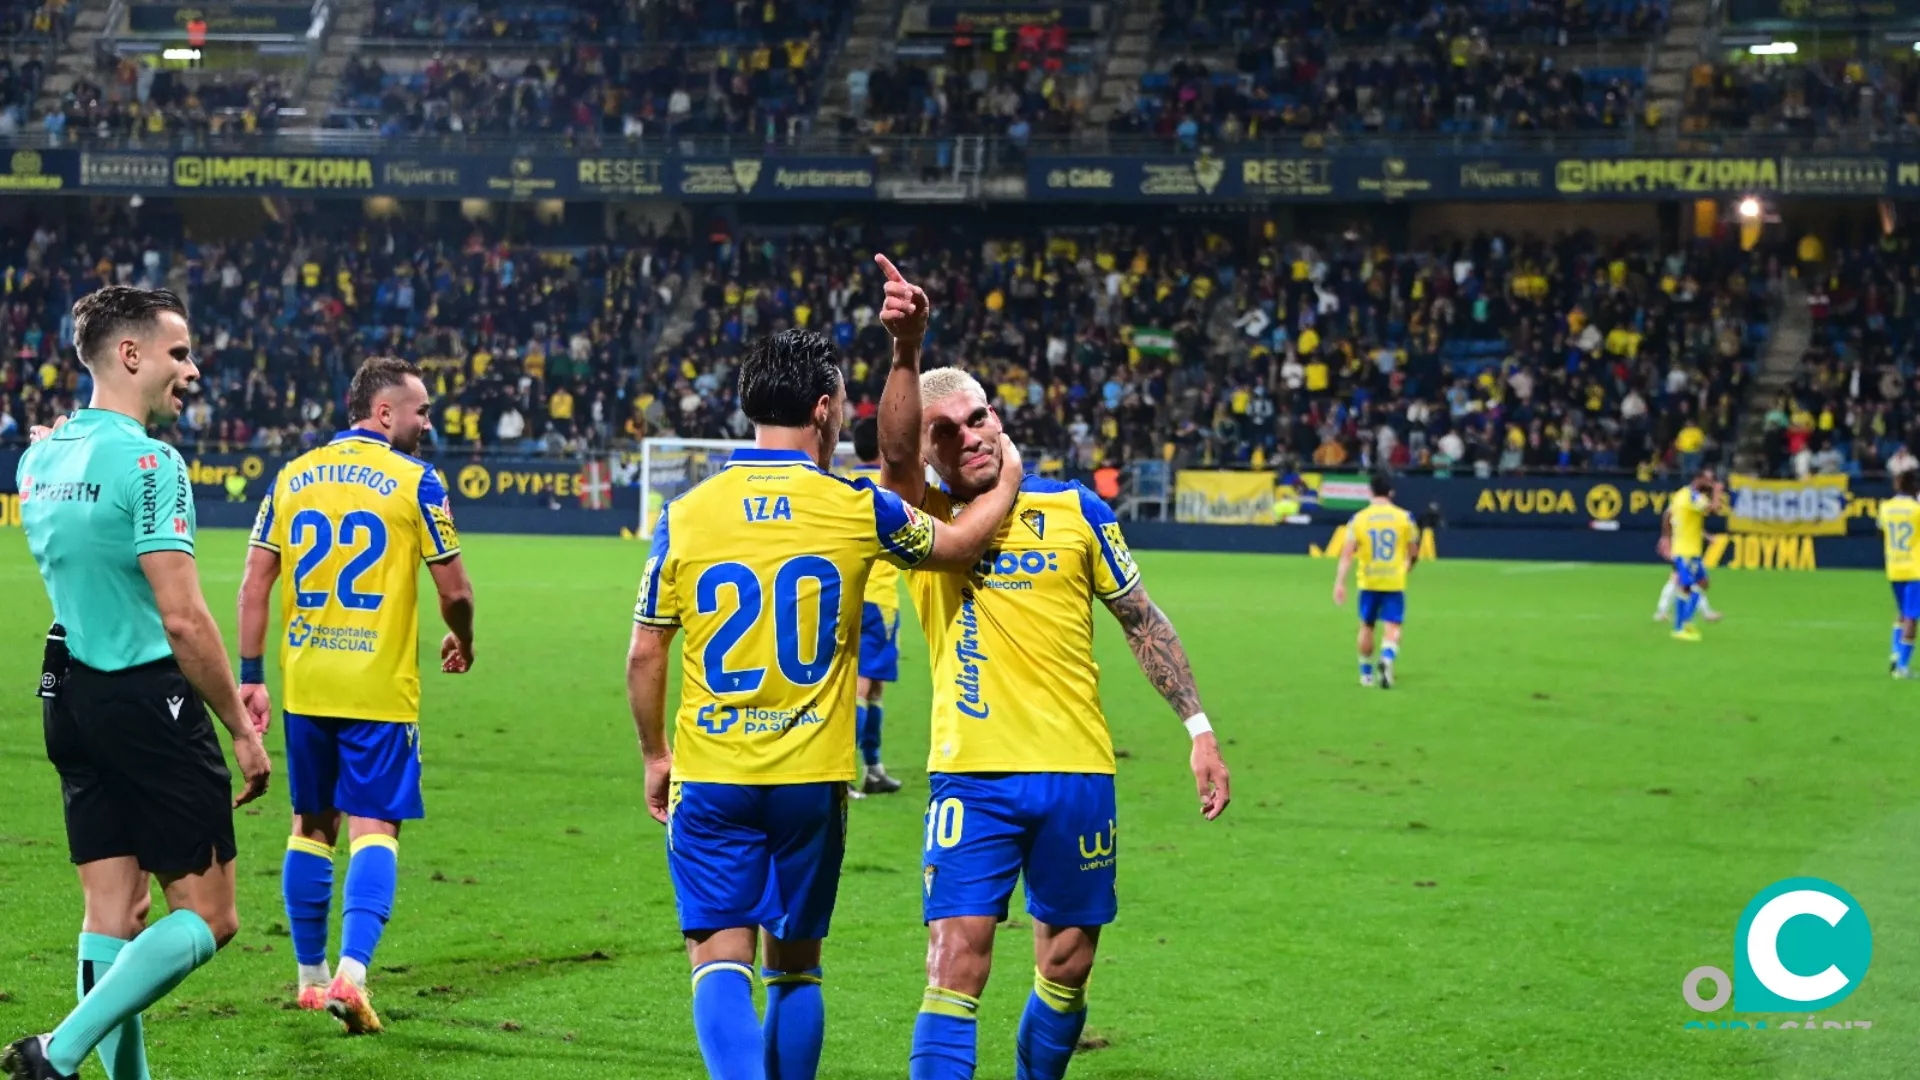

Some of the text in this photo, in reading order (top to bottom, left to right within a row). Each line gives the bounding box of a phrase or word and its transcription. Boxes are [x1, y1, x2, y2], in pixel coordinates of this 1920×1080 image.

[577, 159, 662, 183] RESET
[1243, 160, 1332, 184] RESET
[289, 463, 398, 497] ONTIVEROS
[742, 495, 793, 523] IZA
[1475, 488, 1577, 514] AYUDA
[1732, 488, 1842, 523] ARGOS
[1367, 528, 1397, 562] 18
[1727, 534, 1817, 570] JOYMA
[1888, 521, 1913, 552] 12
[288, 508, 388, 612] 22
[312, 624, 379, 640] Hospitales
[695, 554, 842, 695] 20
[310, 637, 376, 653] PASCUAL
[925, 797, 964, 852] 10
